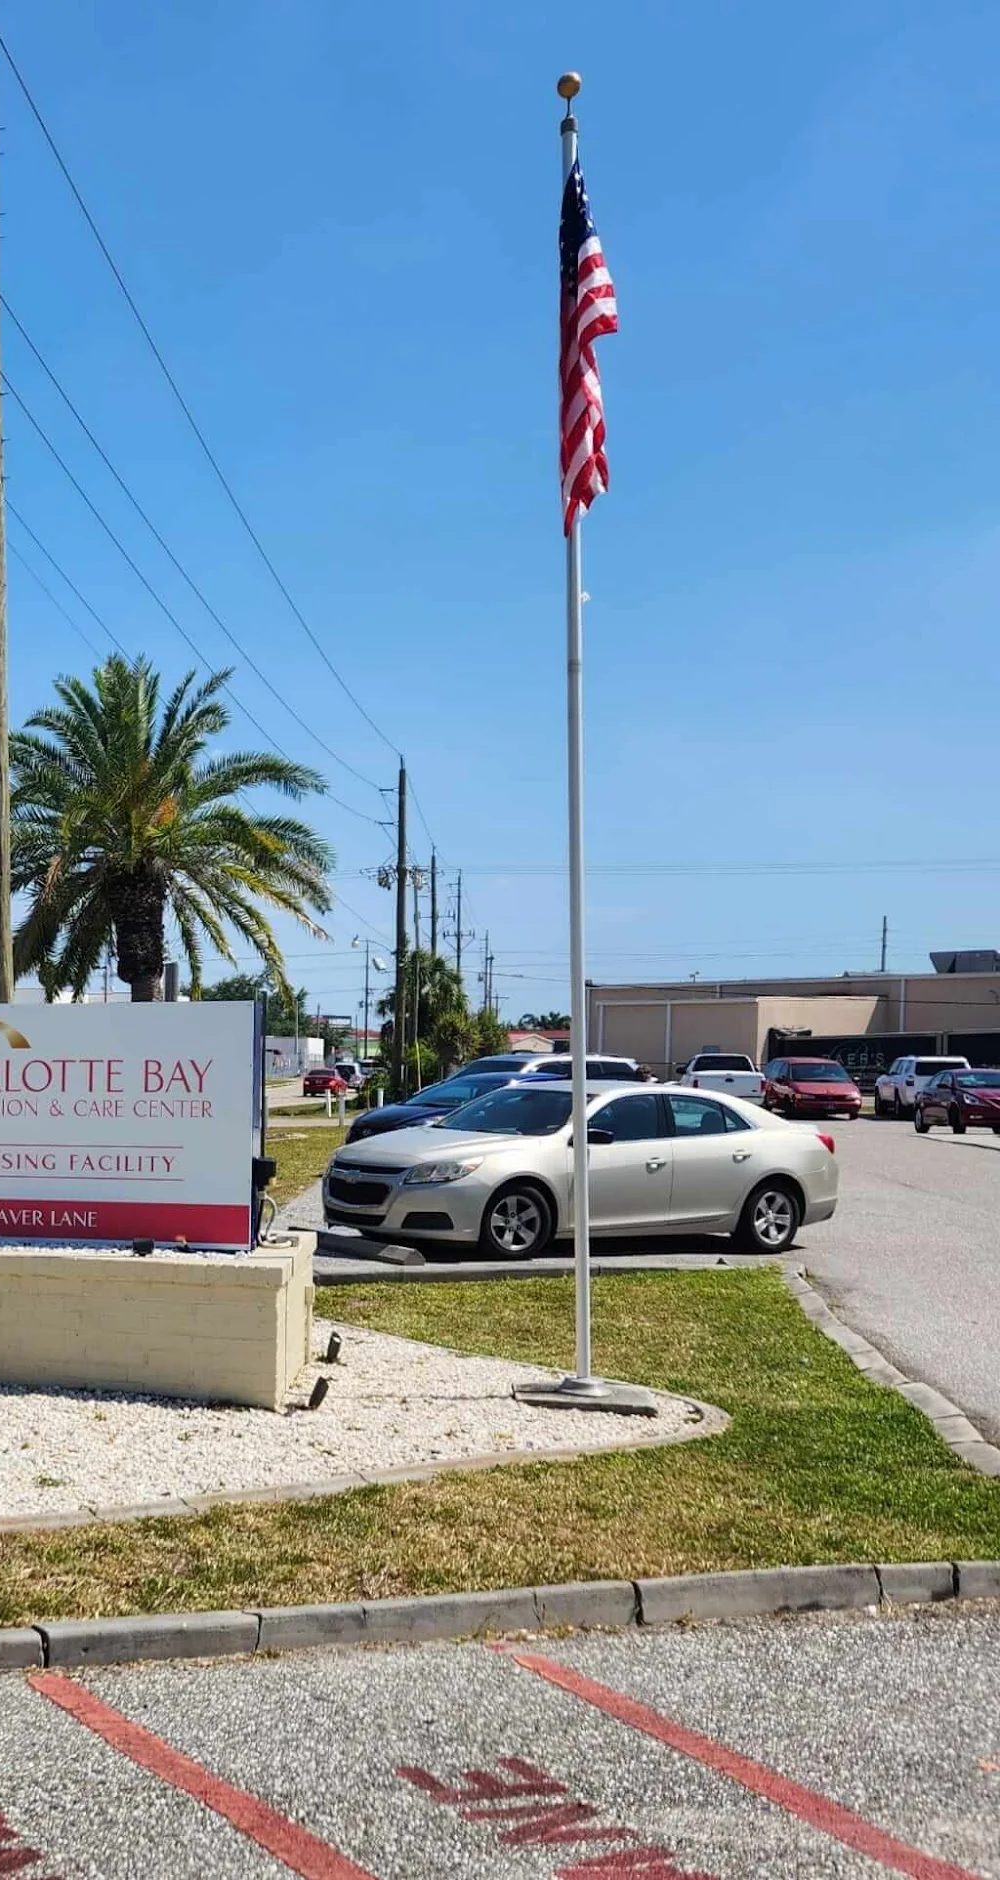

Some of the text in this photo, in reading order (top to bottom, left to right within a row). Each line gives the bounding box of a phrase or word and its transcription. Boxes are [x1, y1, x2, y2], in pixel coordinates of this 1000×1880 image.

[144, 1059, 214, 1093] BAY
[49, 1099, 64, 1117] &
[73, 1099, 124, 1118] CARE
[133, 1099, 213, 1118] CENTER
[70, 1154, 176, 1173] FACILITY
[51, 1210, 98, 1228] LANE
